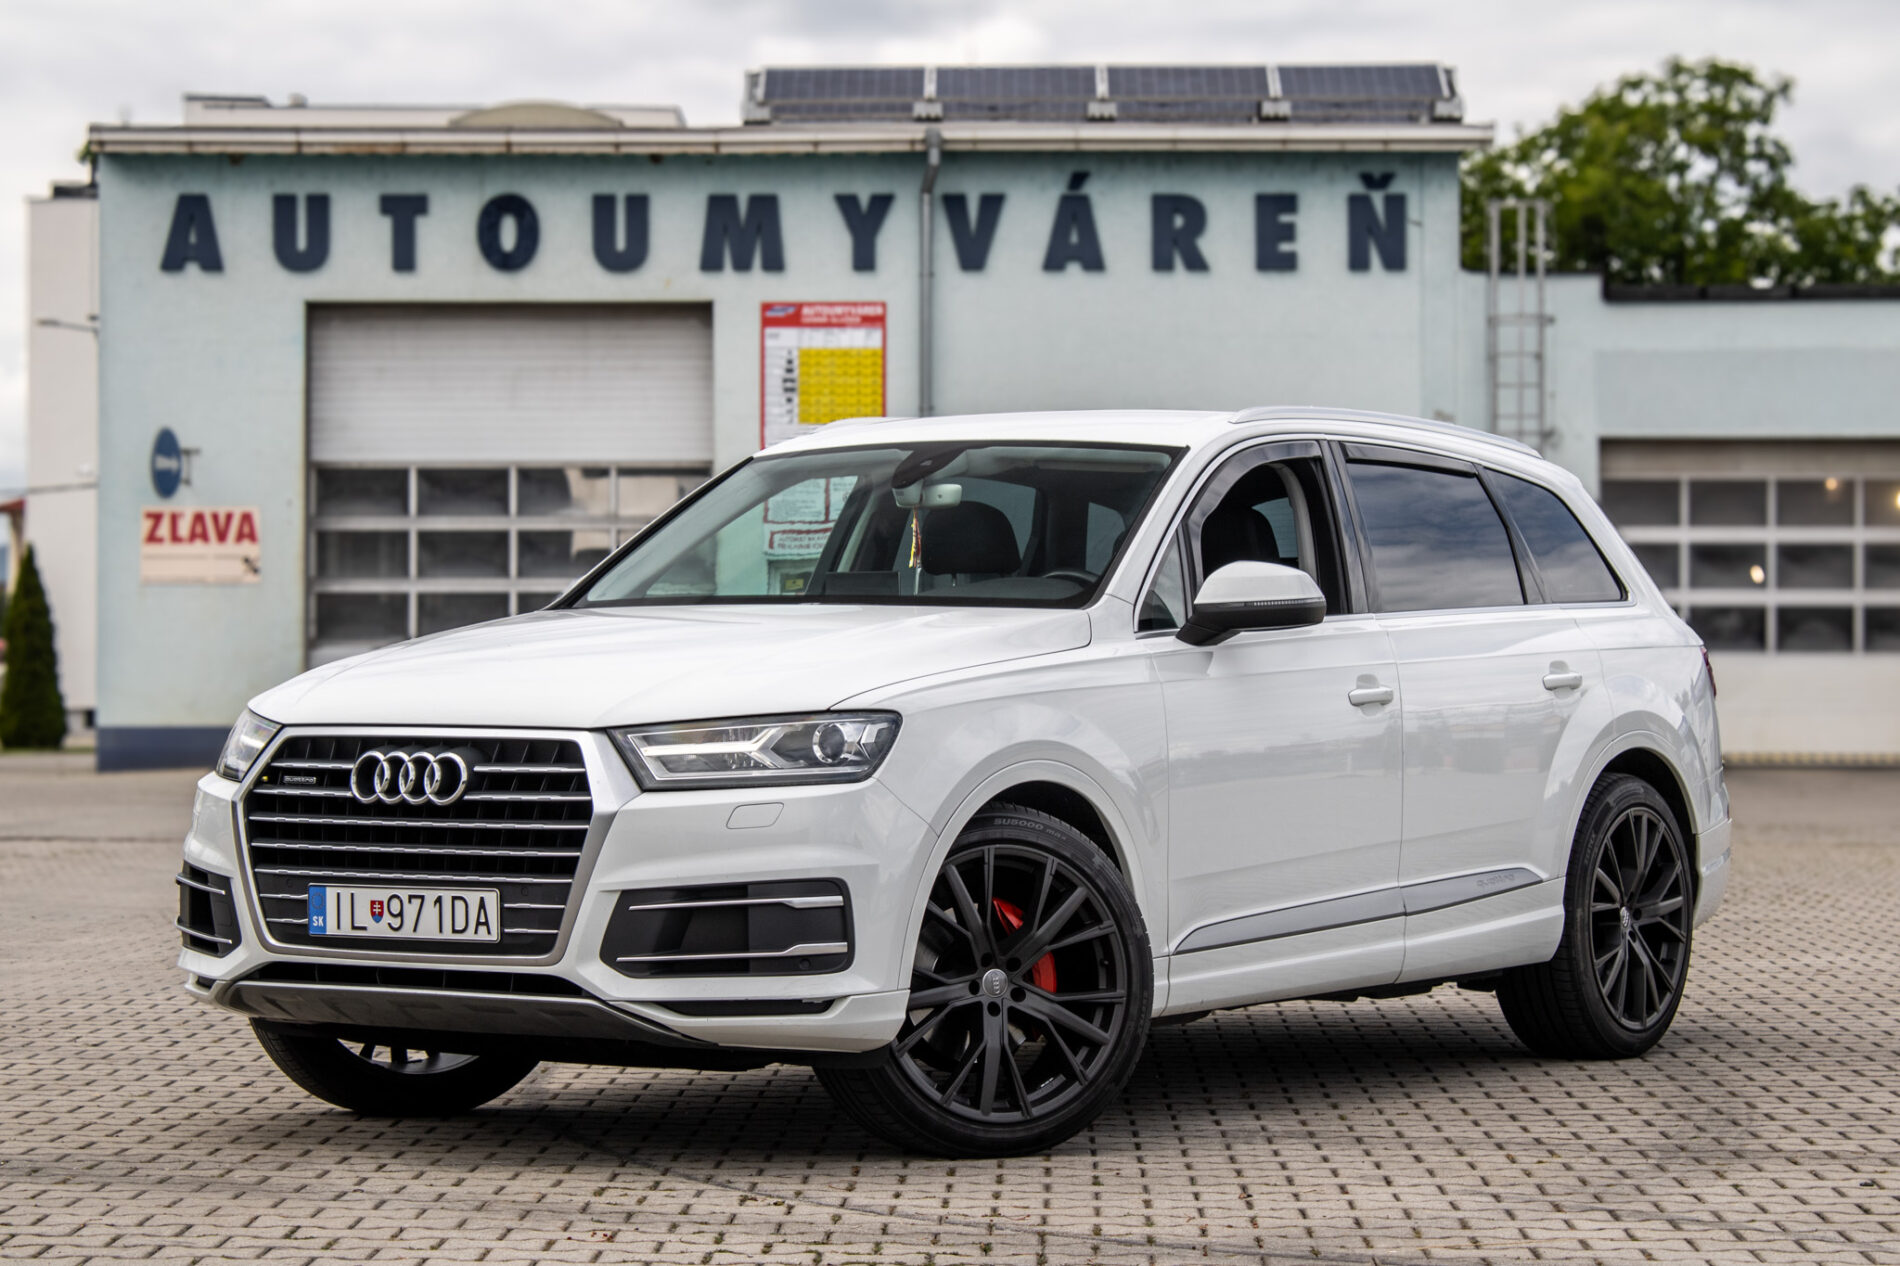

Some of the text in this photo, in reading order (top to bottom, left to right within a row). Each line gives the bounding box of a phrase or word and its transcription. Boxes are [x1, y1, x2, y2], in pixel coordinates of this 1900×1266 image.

[160, 171, 1408, 273] AUTOUMYVÁREŇ
[144, 510, 259, 544] ZĽAVA
[312, 916, 324, 927] SK
[387, 894, 492, 935] 971DA
